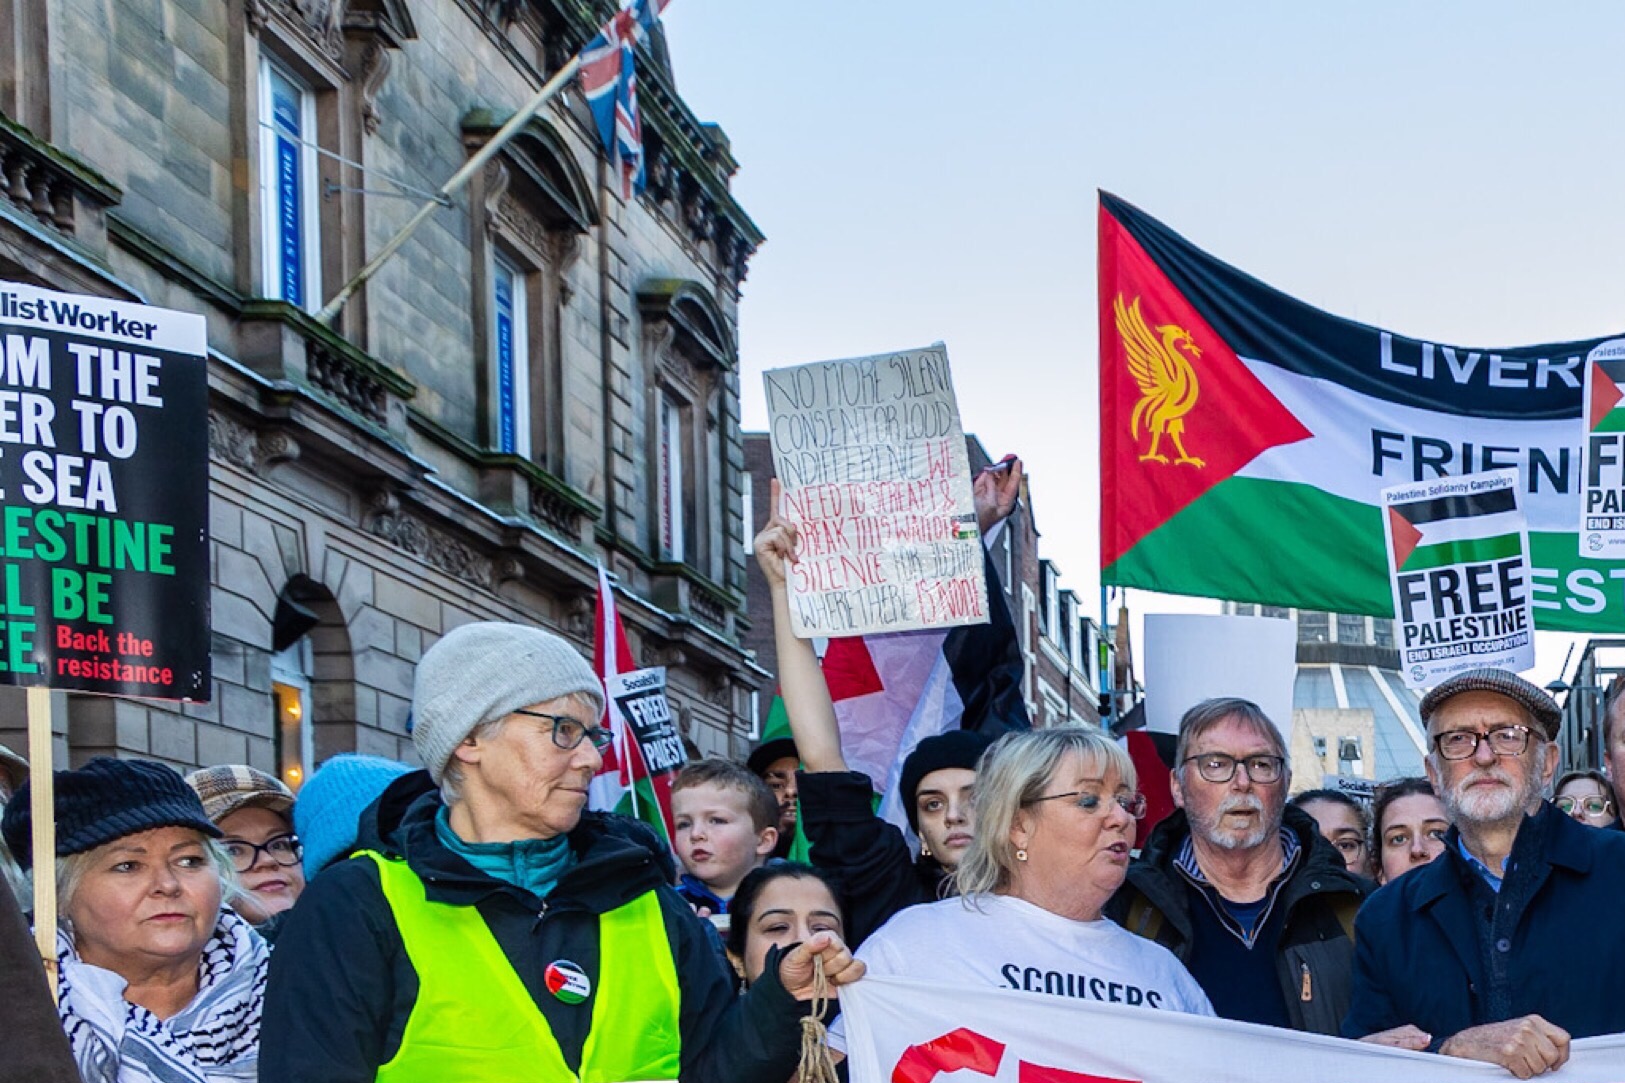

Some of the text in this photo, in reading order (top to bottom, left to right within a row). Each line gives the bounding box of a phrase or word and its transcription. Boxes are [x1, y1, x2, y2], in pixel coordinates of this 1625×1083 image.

[67, 342, 163, 408] THE
[766, 350, 951, 413] NO MORE SILENT
[71, 399, 138, 459] TO
[774, 402, 952, 455] CONSENT OR LOUD
[22, 450, 118, 513] SEA
[926, 438, 958, 481] WE
[1371, 428, 1583, 495] FRIEN
[784, 478, 957, 522] NEED TO SCREAM &
[1386, 475, 1513, 502] Palestine Solidarity Campaign
[0, 505, 176, 576] ESTINE
[794, 518, 850, 560] BREAK
[848, 515, 892, 554] THIS
[1588, 518, 1611, 530] END
[52, 567, 114, 625] BE
[791, 551, 888, 594] SILENCE
[1397, 558, 1526, 624] FREE
[794, 576, 984, 631] WHERE THERE IS NONE
[1403, 607, 1528, 648] PALESTINE
[56, 624, 154, 658] Back the
[1408, 631, 1529, 663] END ISRAELI OCCUPATION
[57, 656, 174, 686] resistance
